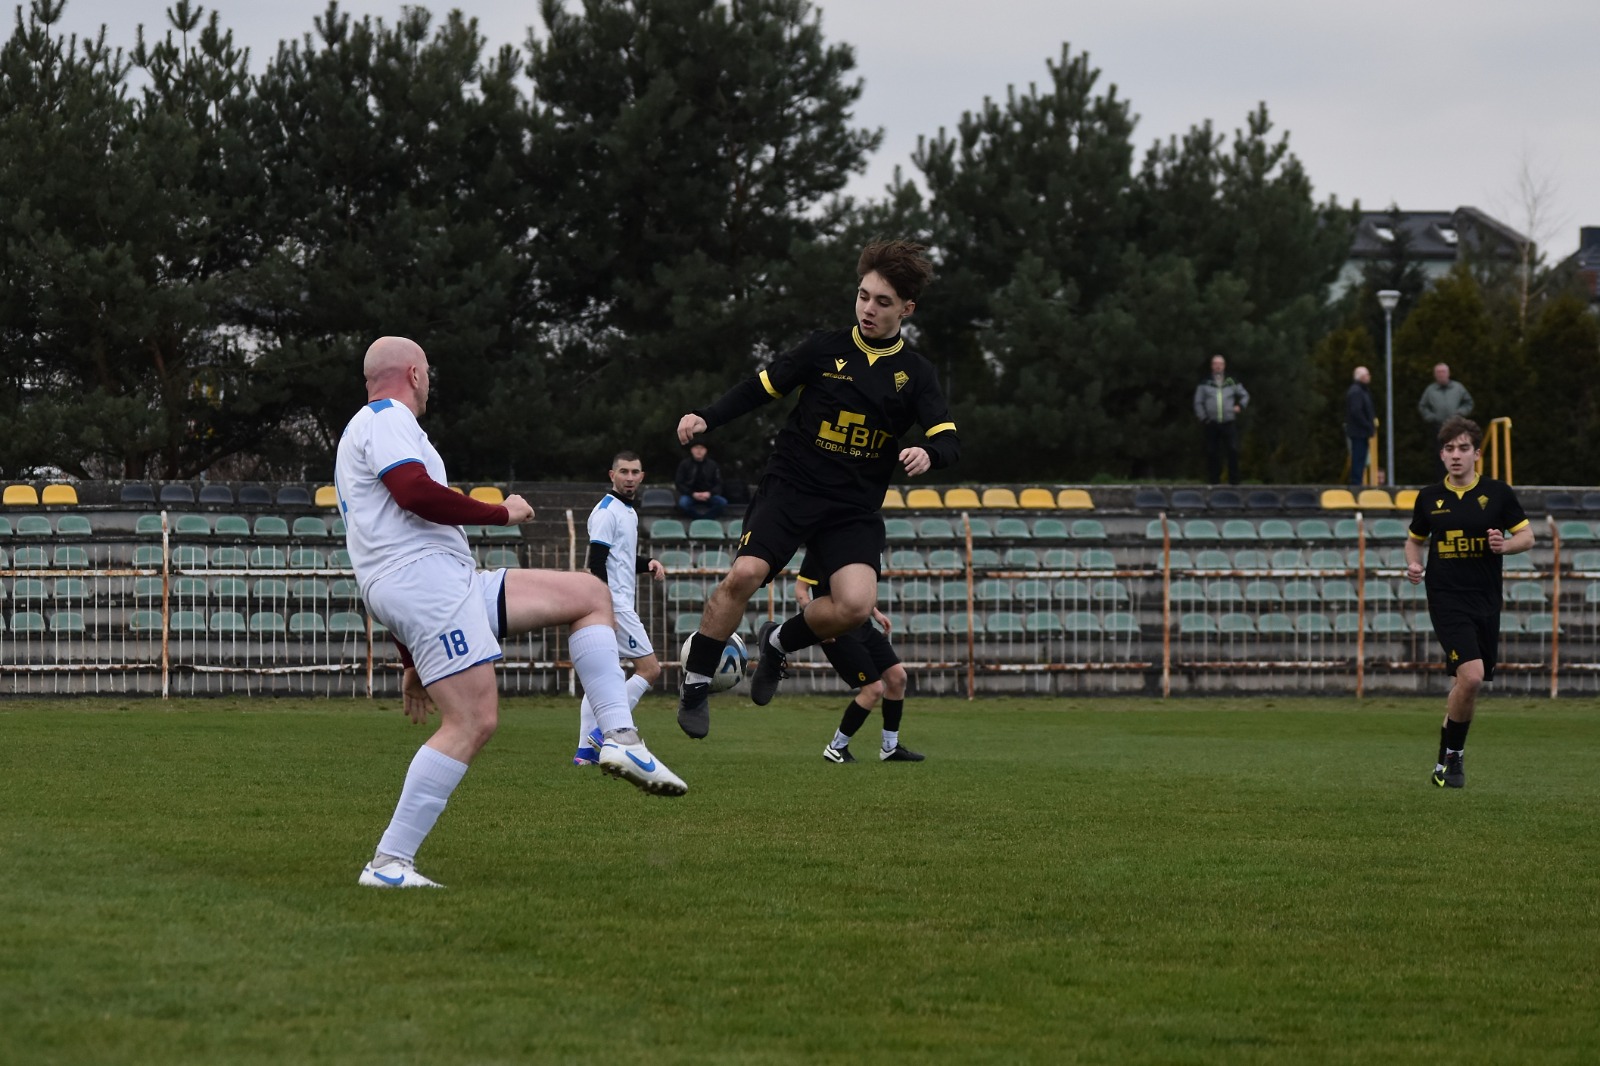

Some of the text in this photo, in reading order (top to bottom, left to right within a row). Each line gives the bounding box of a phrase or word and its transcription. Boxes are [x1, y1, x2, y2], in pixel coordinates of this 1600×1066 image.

[850, 426, 893, 450] BIT
[815, 438, 848, 454] GLOBAL
[849, 447, 863, 458] Sp.
[1457, 537, 1486, 552] BIT
[439, 629, 469, 660] 18
[628, 634, 637, 649] 6
[858, 671, 866, 682] 6
